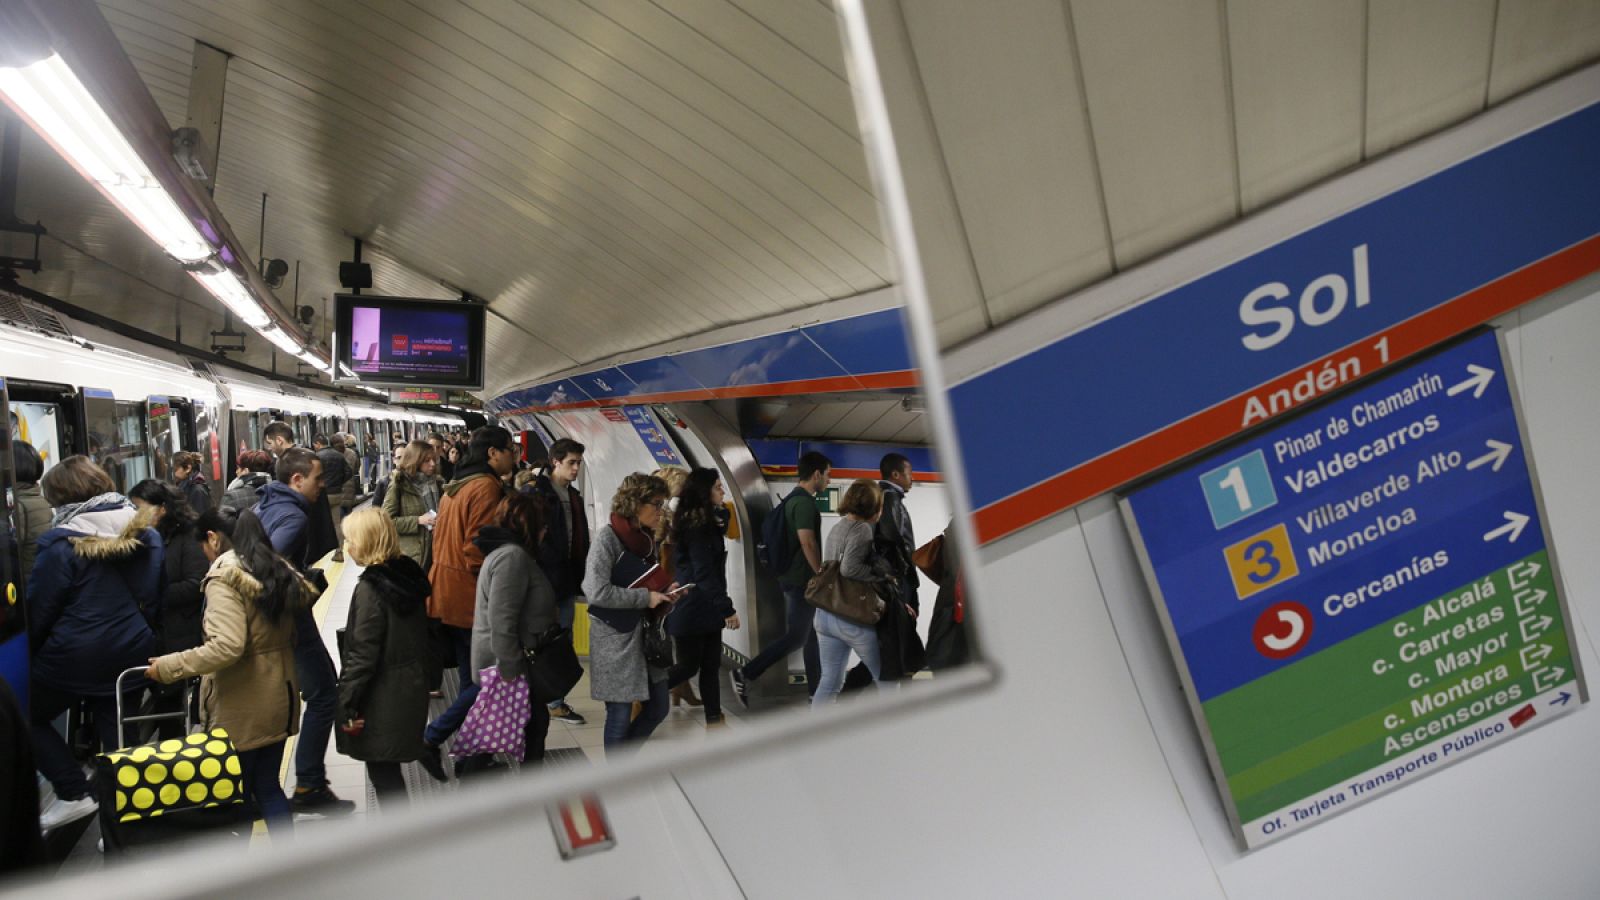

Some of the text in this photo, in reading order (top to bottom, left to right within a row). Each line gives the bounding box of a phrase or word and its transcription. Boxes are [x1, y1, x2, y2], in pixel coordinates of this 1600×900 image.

[1239, 244, 1371, 352] Sol
[1241, 337, 1389, 427] Andén 1
[1274, 373, 1443, 463] Pinar de Chamartín
[1285, 413, 1440, 493] Valdecarros
[1218, 466, 1252, 511] 1
[1296, 450, 1462, 534] Villaverde Alto
[1243, 540, 1281, 585] 3
[1307, 508, 1417, 567] Moncloa
[1323, 550, 1449, 617] Cercanías
[1393, 576, 1496, 637] c. Alcalá
[1372, 605, 1505, 675] c. Carretas
[1408, 632, 1509, 688] c. Mayor
[1384, 665, 1508, 729] c. Montera
[1384, 684, 1522, 755] Ascensores
[1261, 722, 1505, 835] Of. Tarjeta Transporte Público
